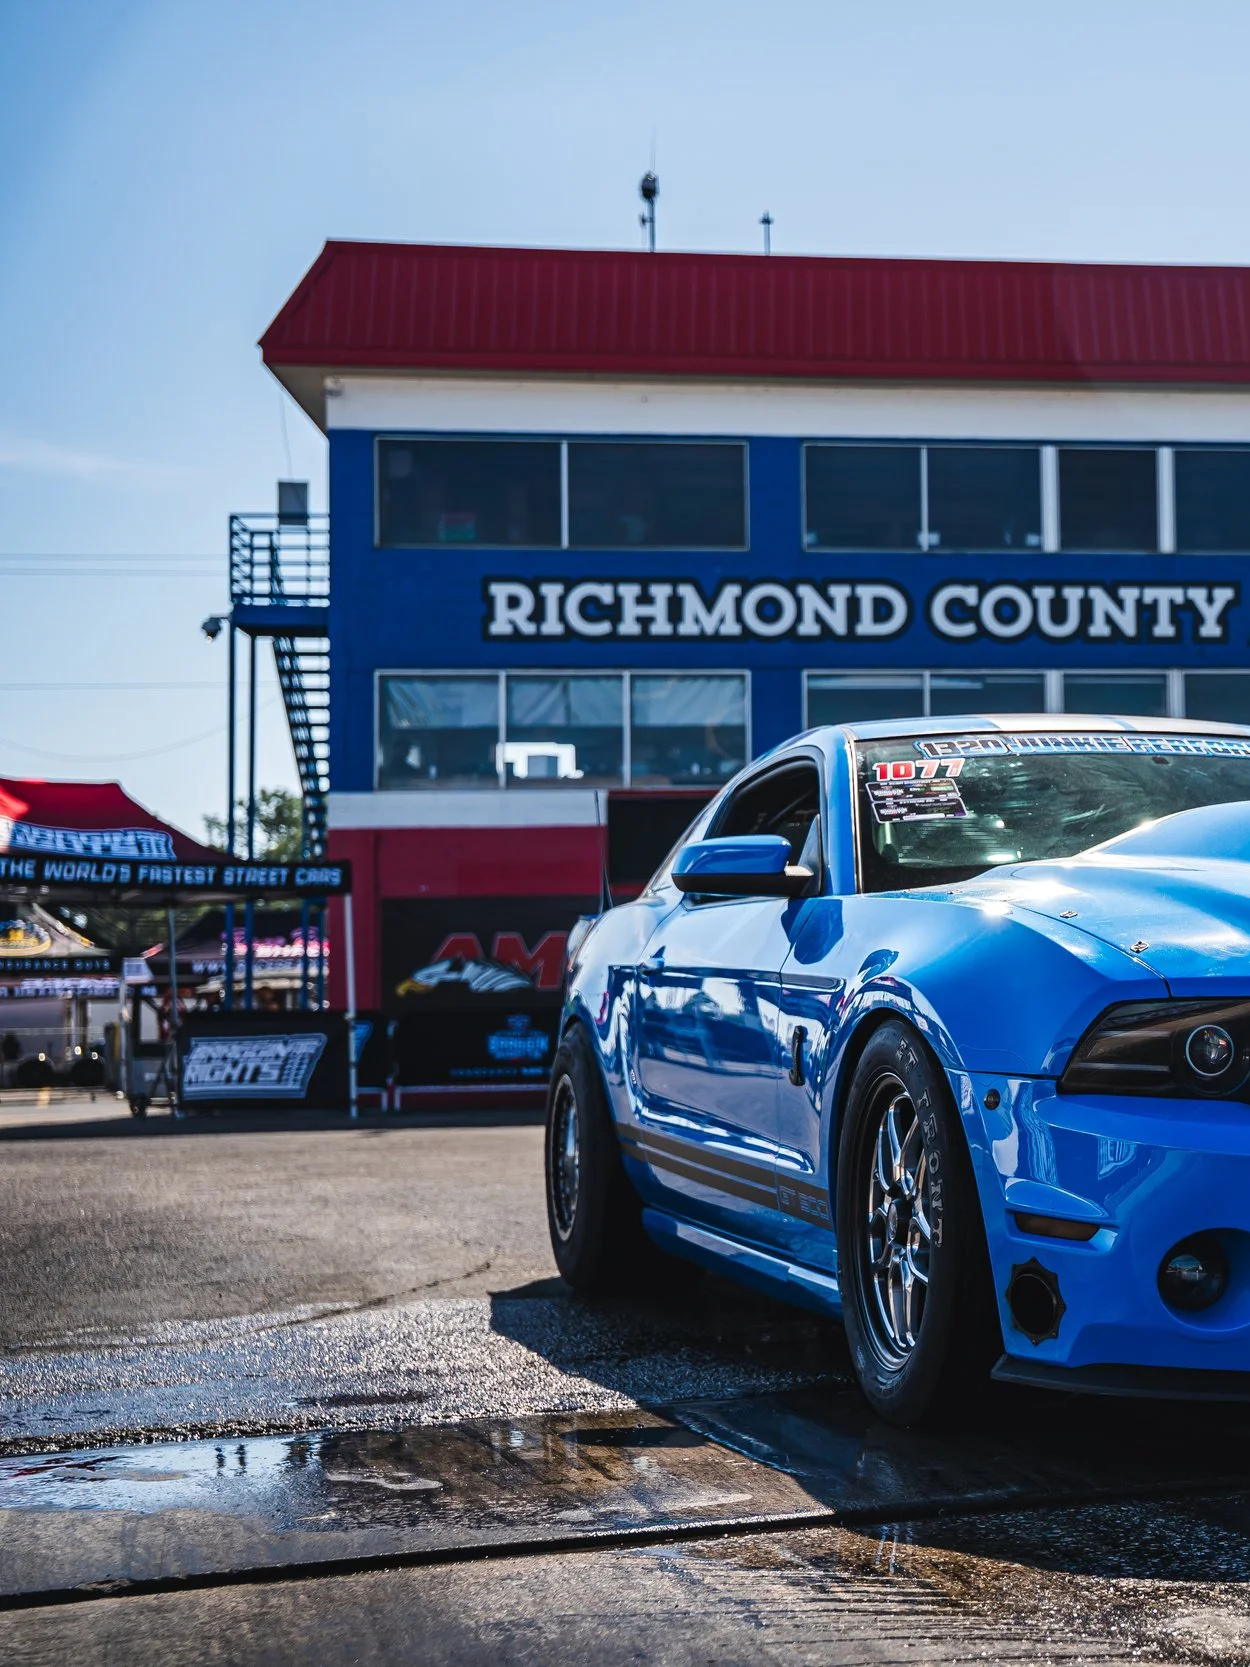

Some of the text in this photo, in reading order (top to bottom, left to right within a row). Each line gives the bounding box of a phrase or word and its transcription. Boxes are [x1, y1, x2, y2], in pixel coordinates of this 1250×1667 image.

[488, 582, 908, 637] RICHMOND
[930, 584, 1235, 637] COUNTY
[921, 738, 1009, 758] 1320
[1009, 735, 1126, 754] JUNKIE
[873, 757, 965, 782] 1077
[0, 857, 36, 879] THE
[138, 864, 217, 886] FASTEST
[222, 866, 289, 886] STREET
[294, 868, 343, 887] CARS
[917, 1086, 945, 1248] FRONT
